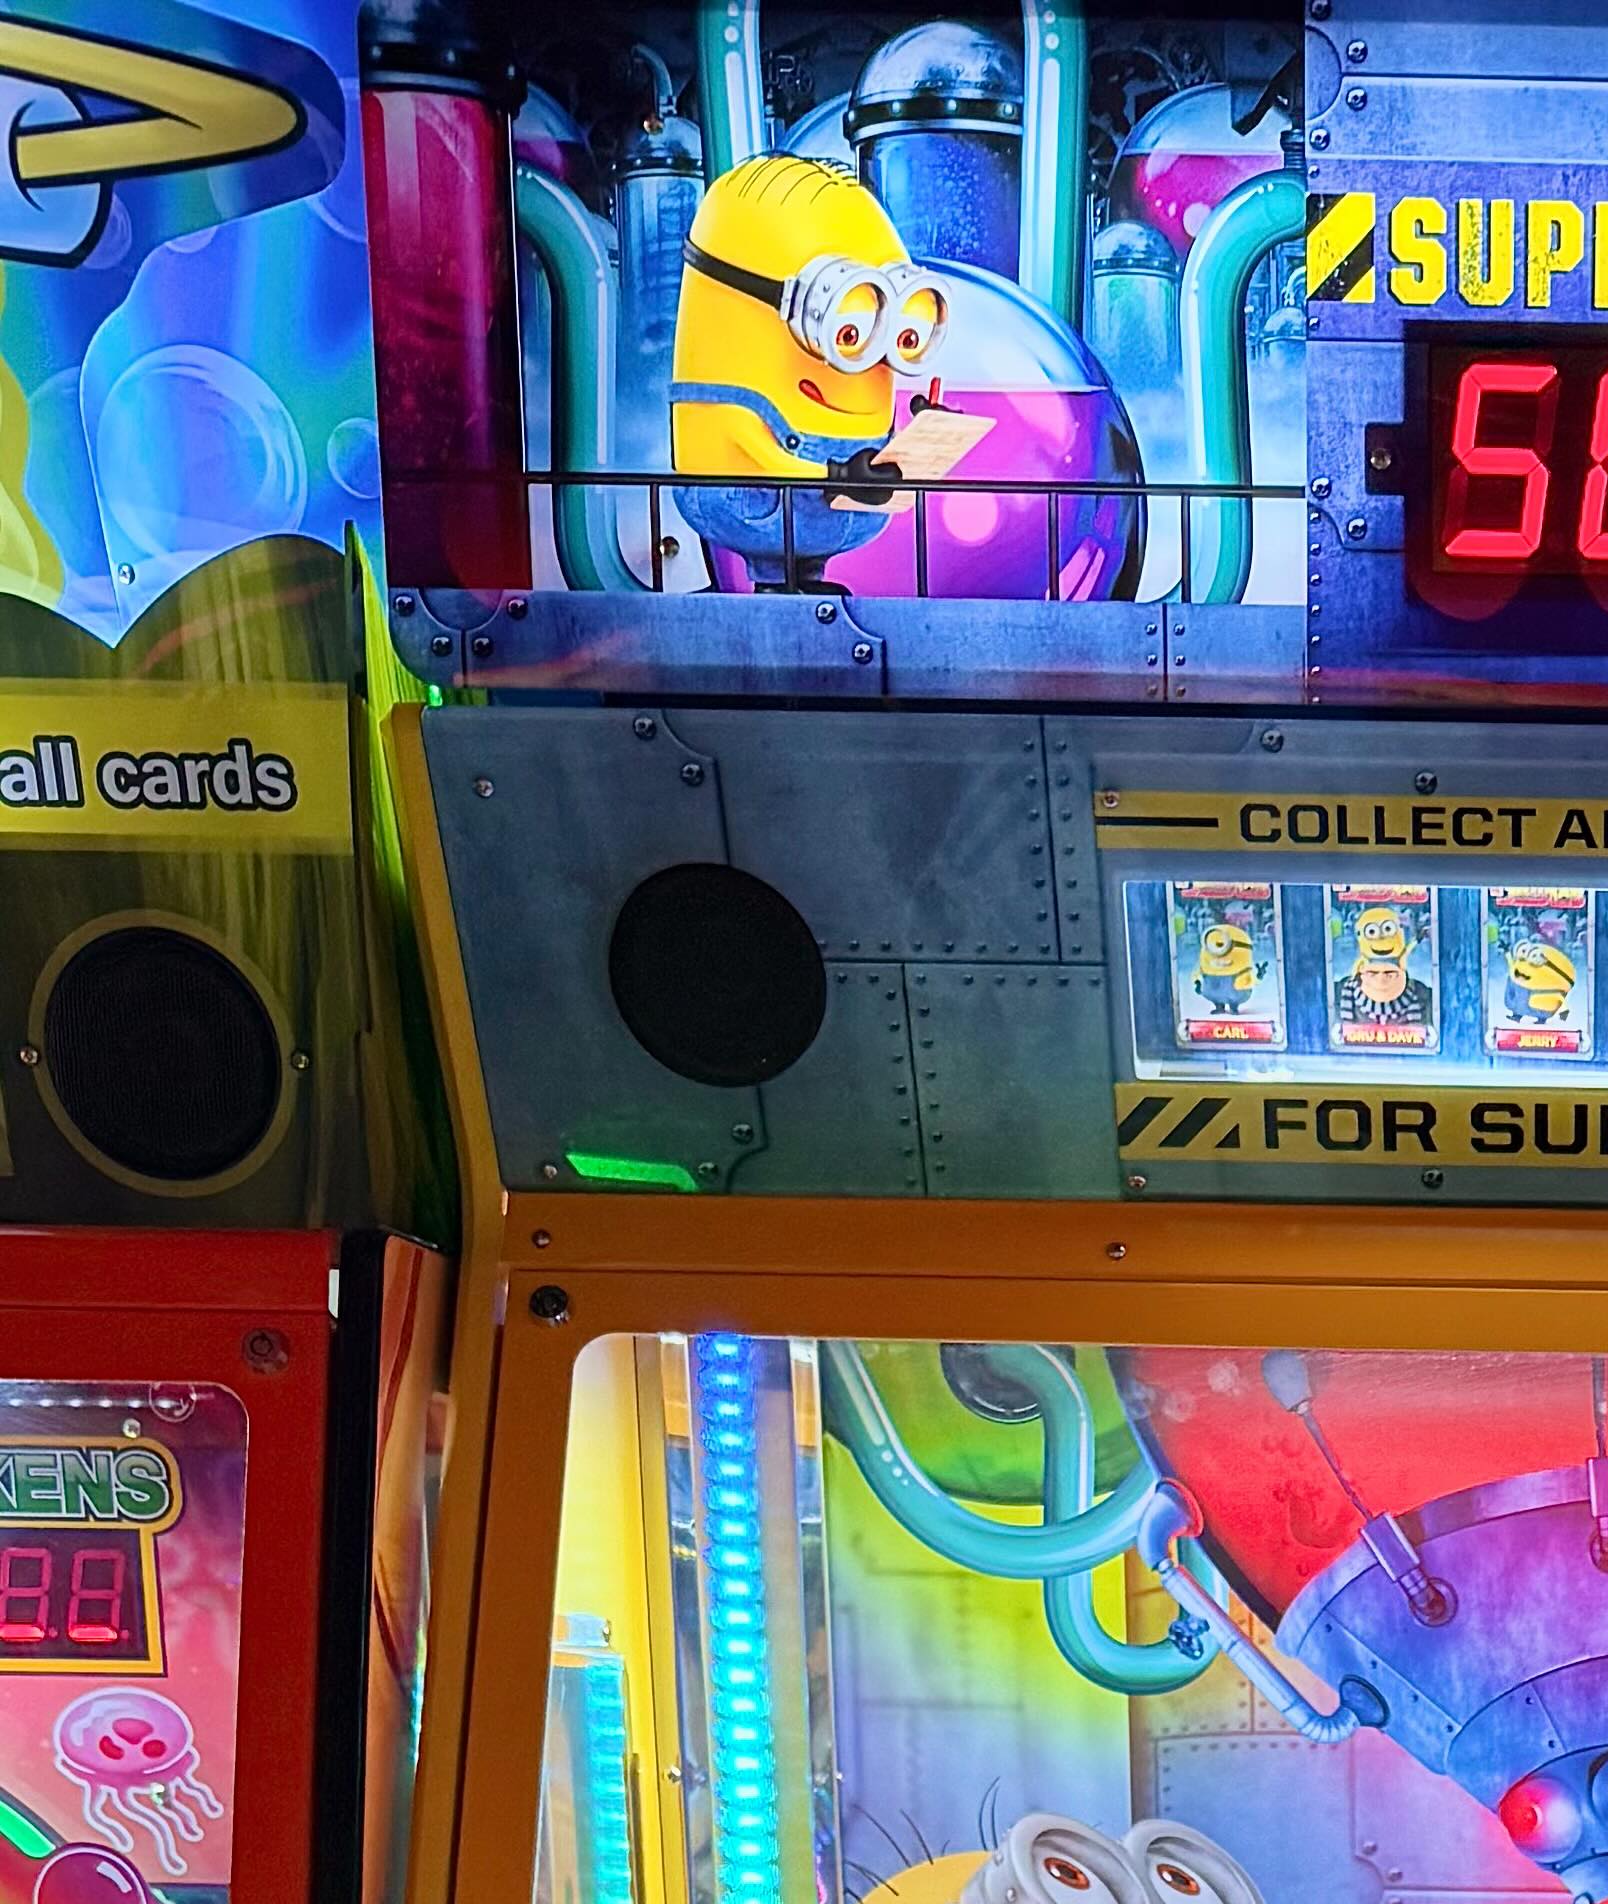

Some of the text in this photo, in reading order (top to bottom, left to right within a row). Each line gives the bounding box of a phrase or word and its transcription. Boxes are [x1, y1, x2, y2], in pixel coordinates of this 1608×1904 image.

[0, 737, 295, 809] all cards
[1239, 803, 1538, 848] COLLECT
[1213, 1026, 1249, 1039] CARL
[1263, 1099, 1438, 1153] FOR
